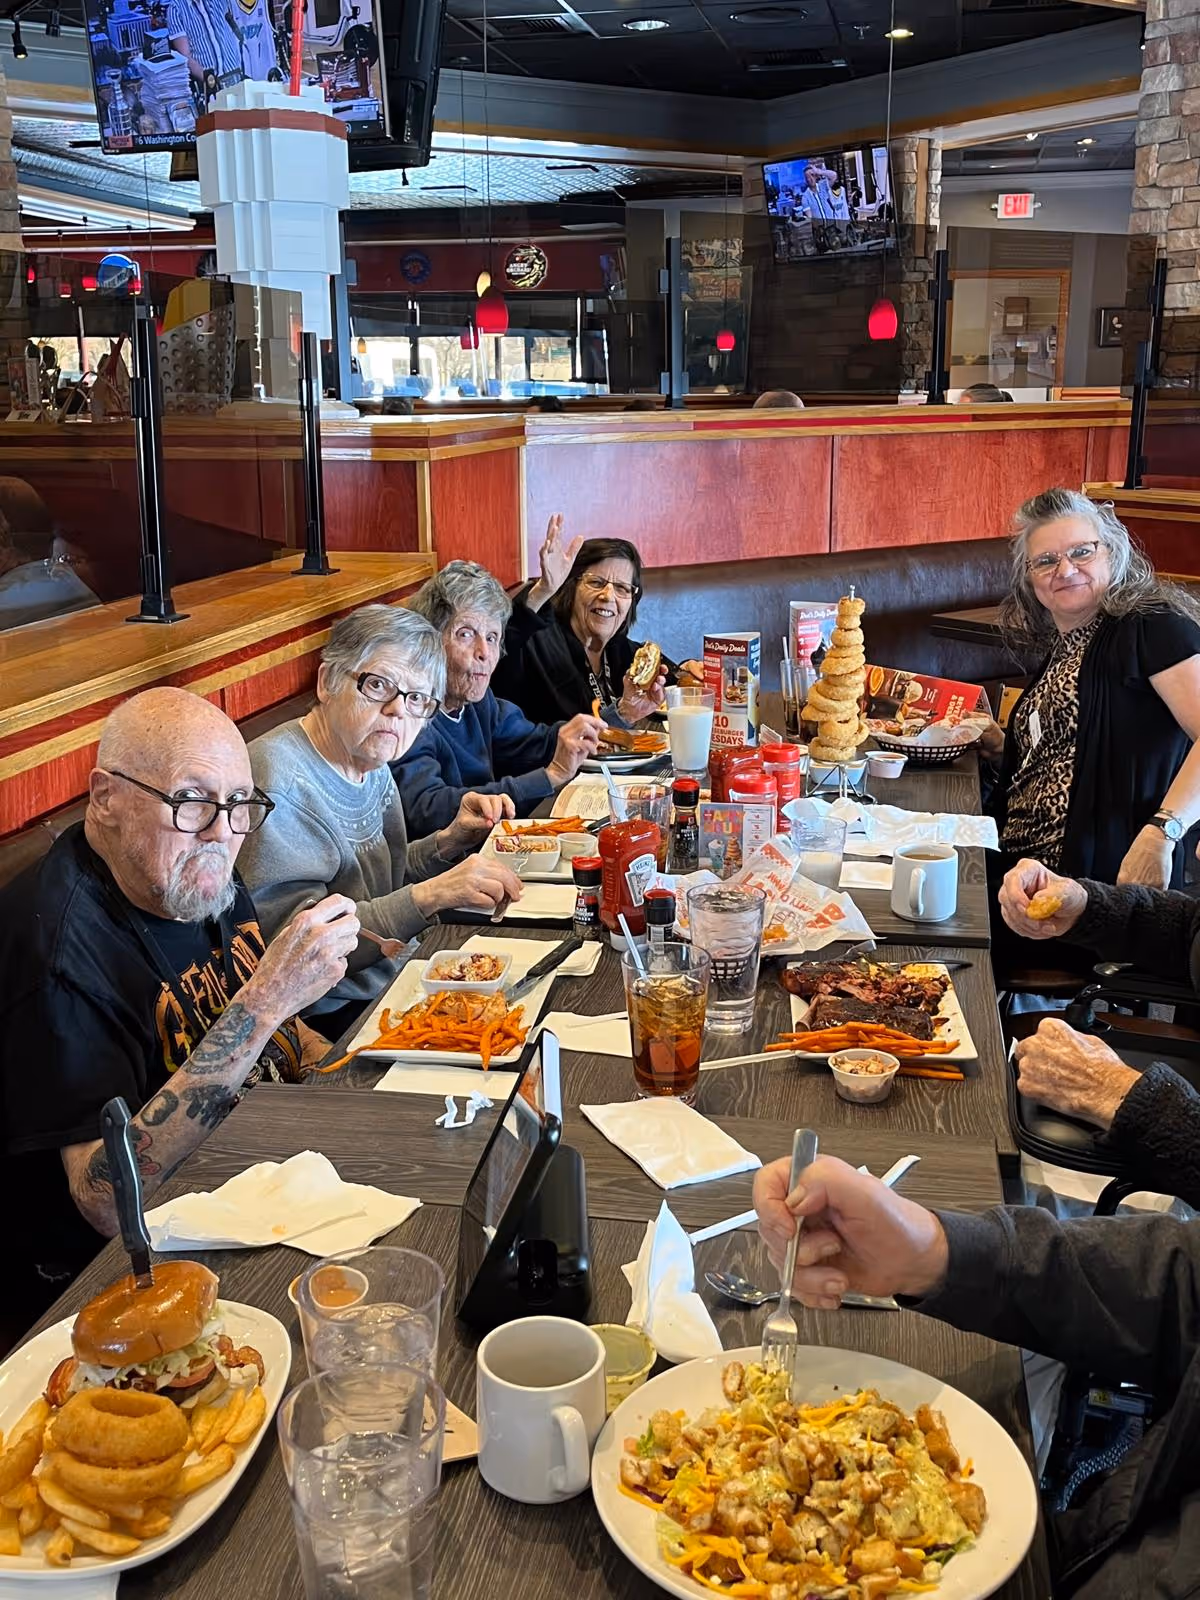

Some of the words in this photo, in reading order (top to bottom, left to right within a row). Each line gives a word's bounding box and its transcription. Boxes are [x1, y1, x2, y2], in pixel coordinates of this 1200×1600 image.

[144, 135, 185, 146] Washington
[1003, 195, 1030, 216] EXIT
[714, 642, 729, 654] Daily
